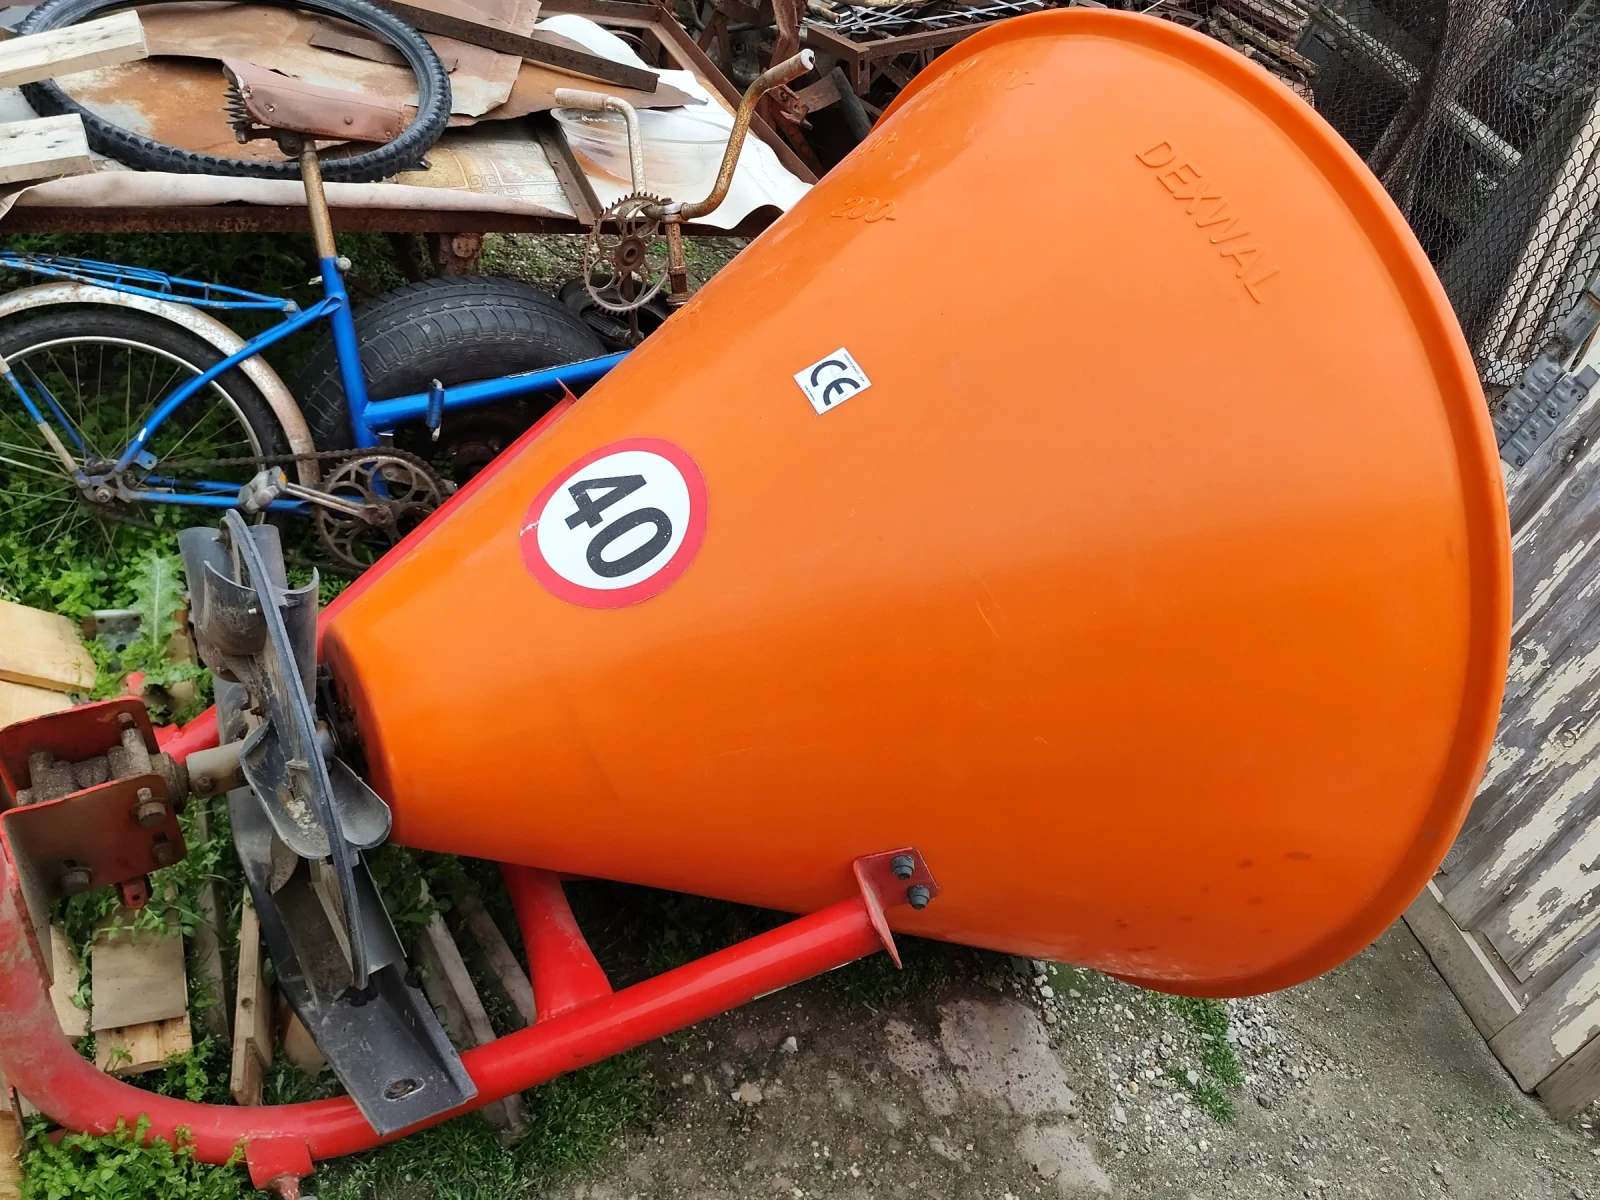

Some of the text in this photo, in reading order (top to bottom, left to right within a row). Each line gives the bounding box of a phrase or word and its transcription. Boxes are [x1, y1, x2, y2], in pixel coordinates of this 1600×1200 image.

[1134, 140, 1281, 305] DEXWAL
[810, 359, 861, 406] CE
[564, 474, 673, 578] 40
